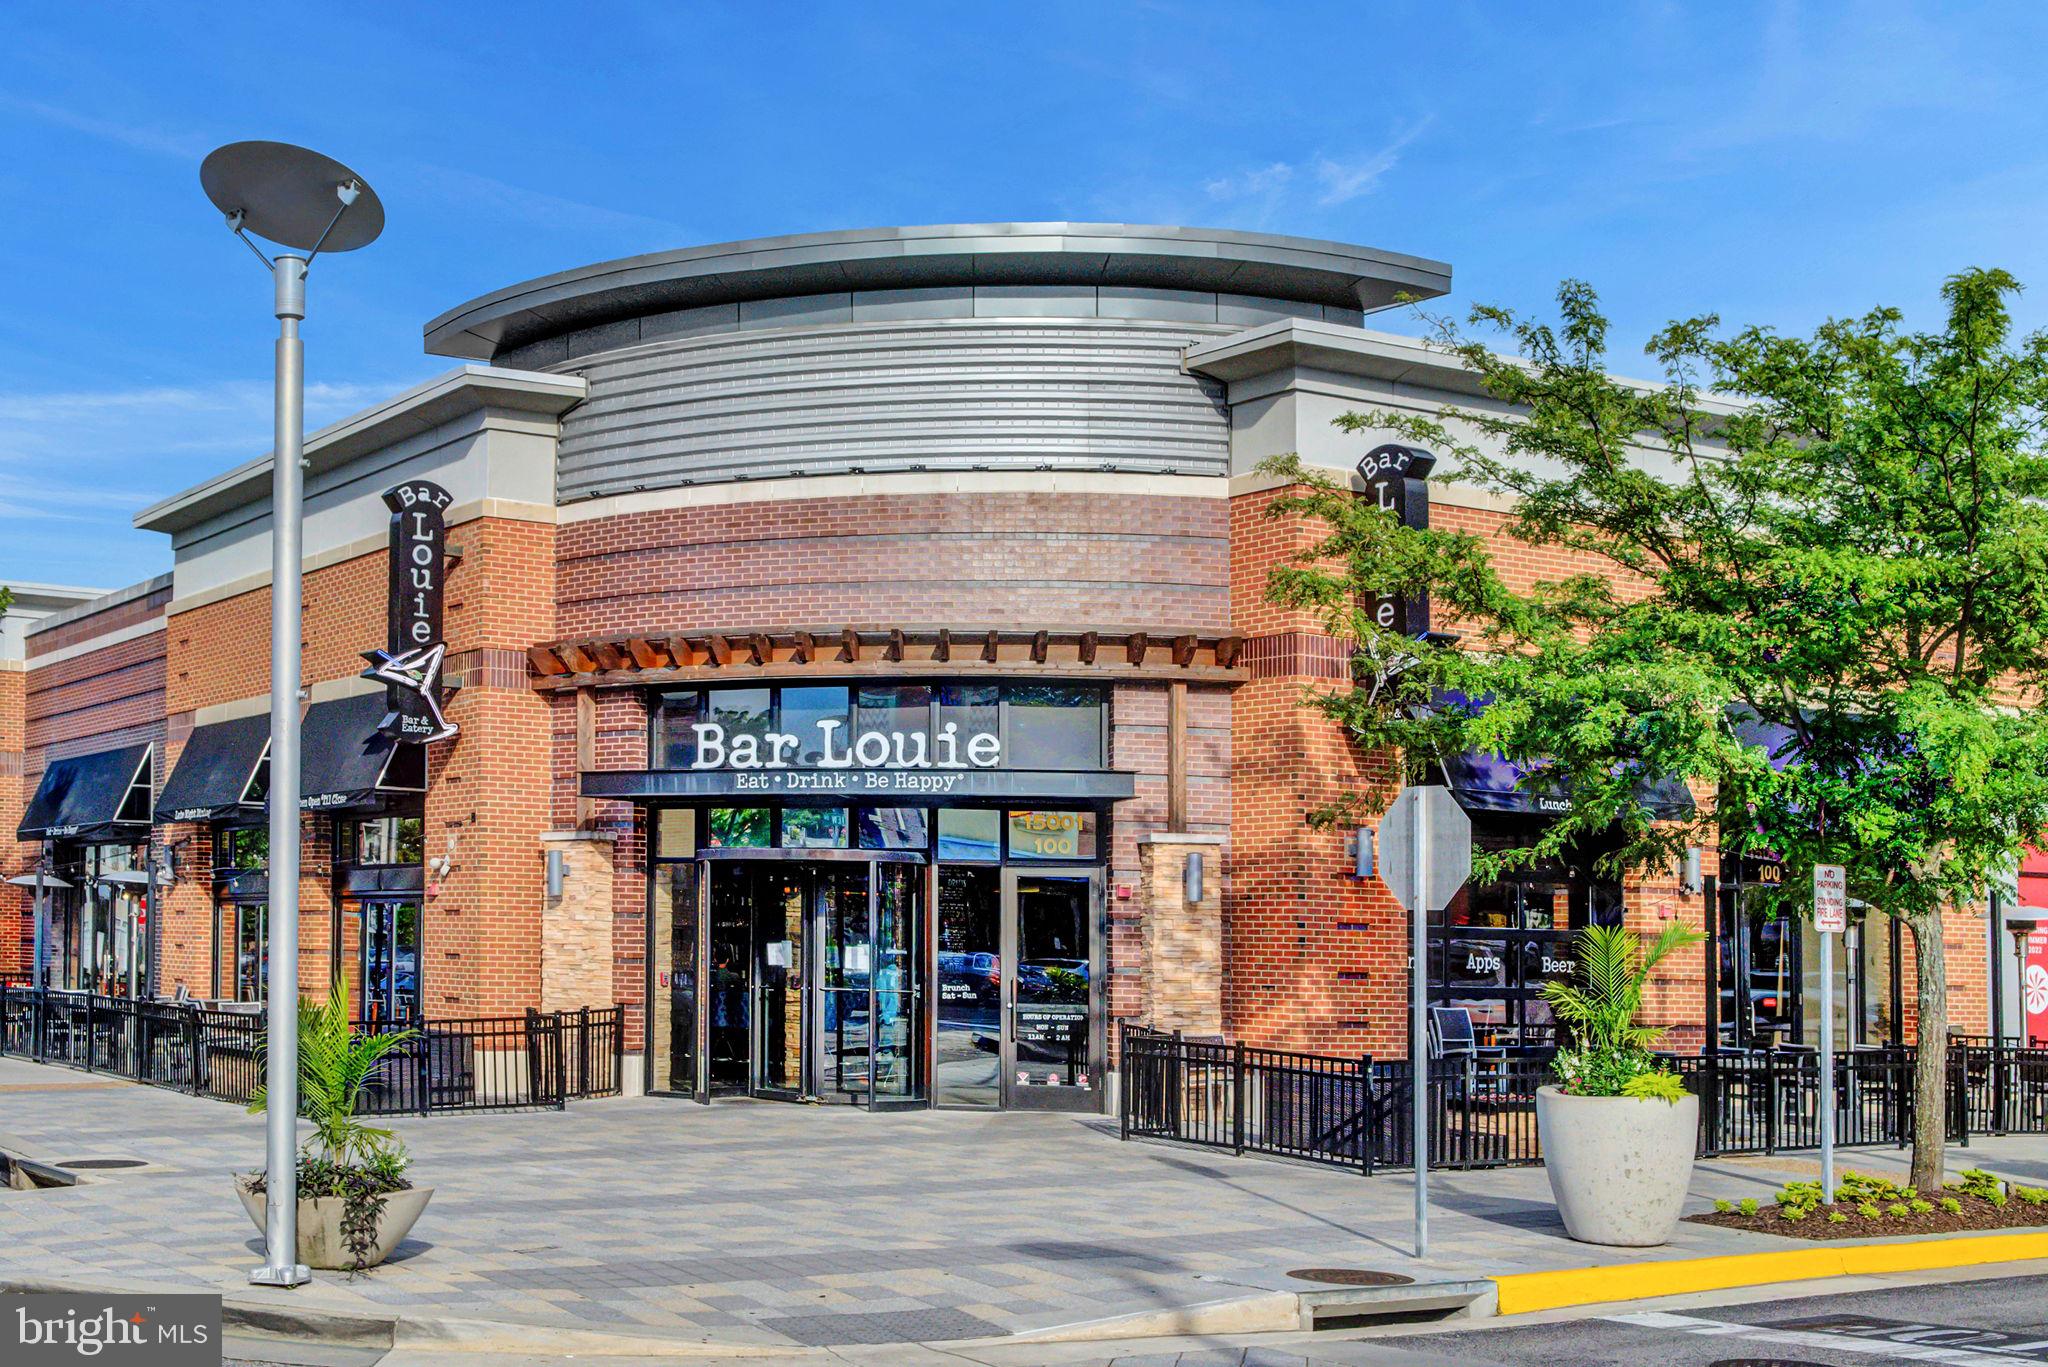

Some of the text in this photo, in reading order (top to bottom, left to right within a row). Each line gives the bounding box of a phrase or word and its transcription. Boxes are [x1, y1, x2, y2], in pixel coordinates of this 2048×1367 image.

[1360, 452, 1410, 480] Bar
[397, 485, 450, 509] Bar
[410, 512, 434, 643] Louie
[401, 714, 429, 726] Bar &
[401, 724, 434, 735] Eatery
[691, 719, 1001, 769] Bar Louie
[736, 773, 769, 789] Eat
[786, 772, 848, 789] Drink
[864, 773, 889, 788] Be
[1539, 797, 1573, 811] Lunch
[1024, 813, 1084, 831] 15001
[1034, 837, 1072, 854] 100
[1758, 864, 1781, 883] 100
[1824, 870, 1835, 879] NO
[1816, 880, 1843, 890] PARKING
[1816, 896, 1843, 907] STANDING
[1829, 908, 1843, 919] LANE
[1466, 952, 1576, 974] Apps Beer
[941, 984, 971, 992] Brunch
[941, 992, 956, 1000] Sat
